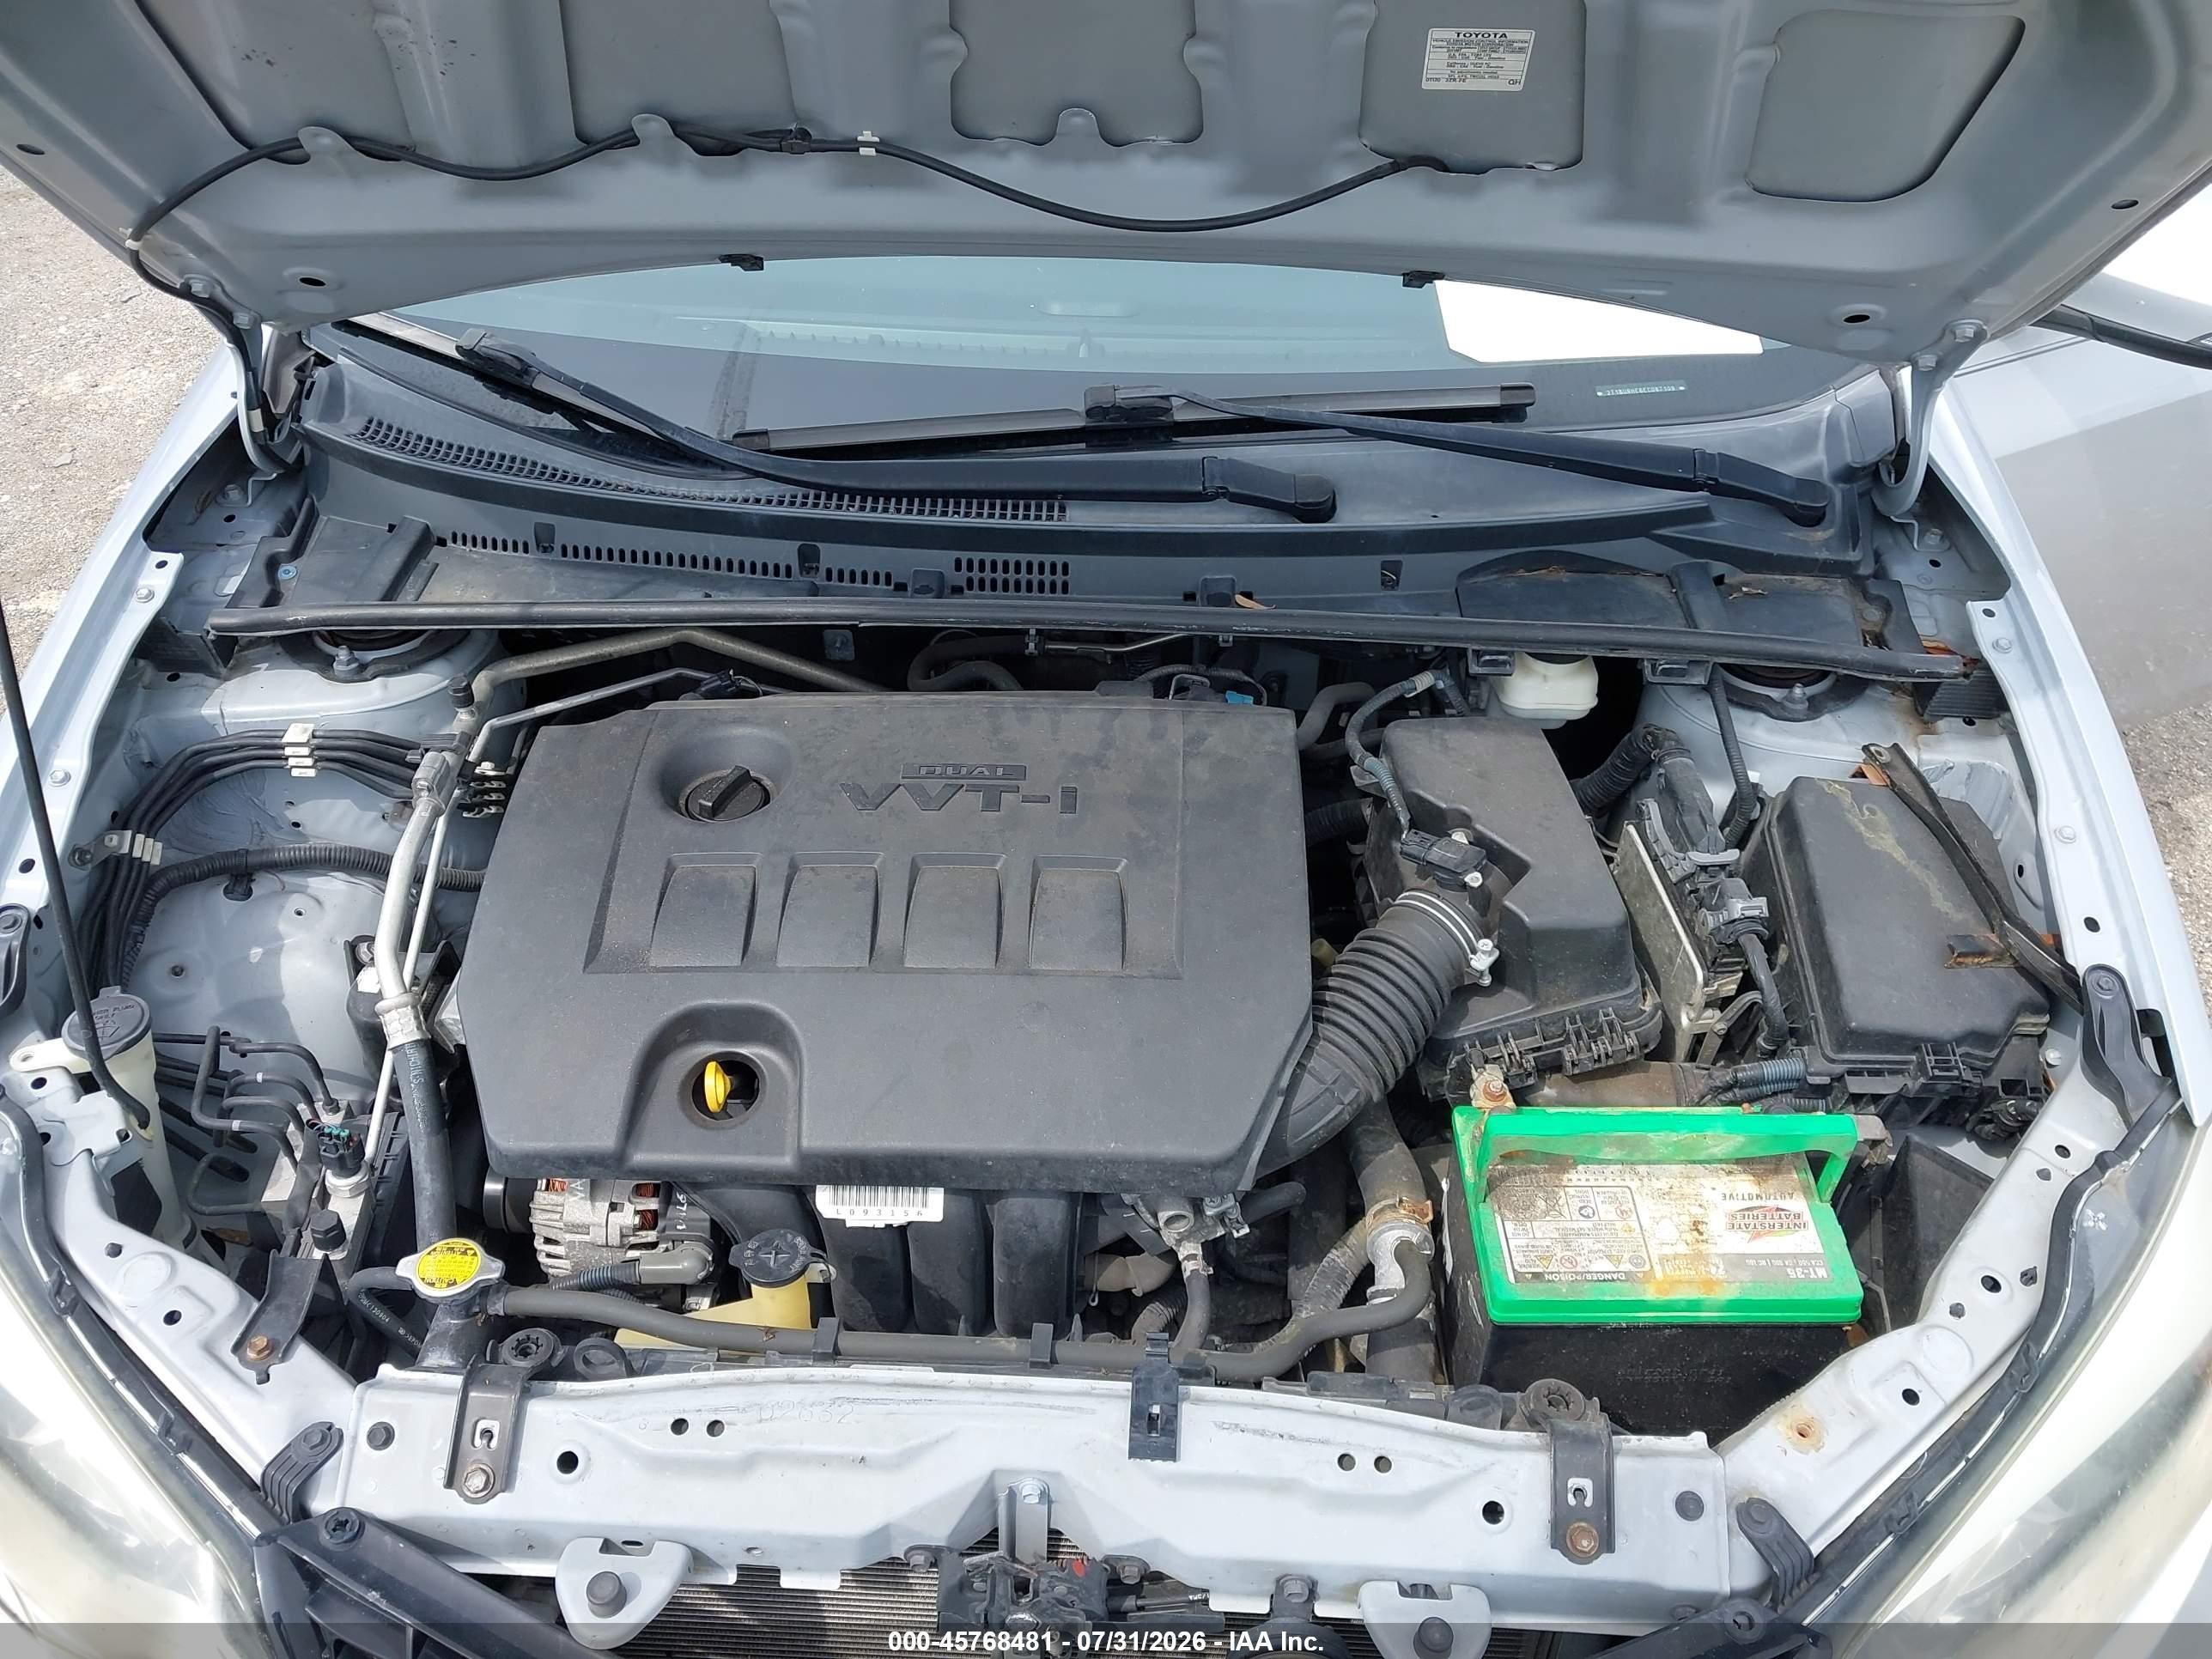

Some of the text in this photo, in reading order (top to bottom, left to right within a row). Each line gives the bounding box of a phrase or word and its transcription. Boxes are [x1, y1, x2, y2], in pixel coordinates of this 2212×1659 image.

[919, 765, 1013, 777] DUAL
[1726, 1222, 1808, 1231] INTERSTATE
[1545, 1272, 1626, 1280] DANGER/POISON
[1787, 1267, 1827, 1279] MT-35
